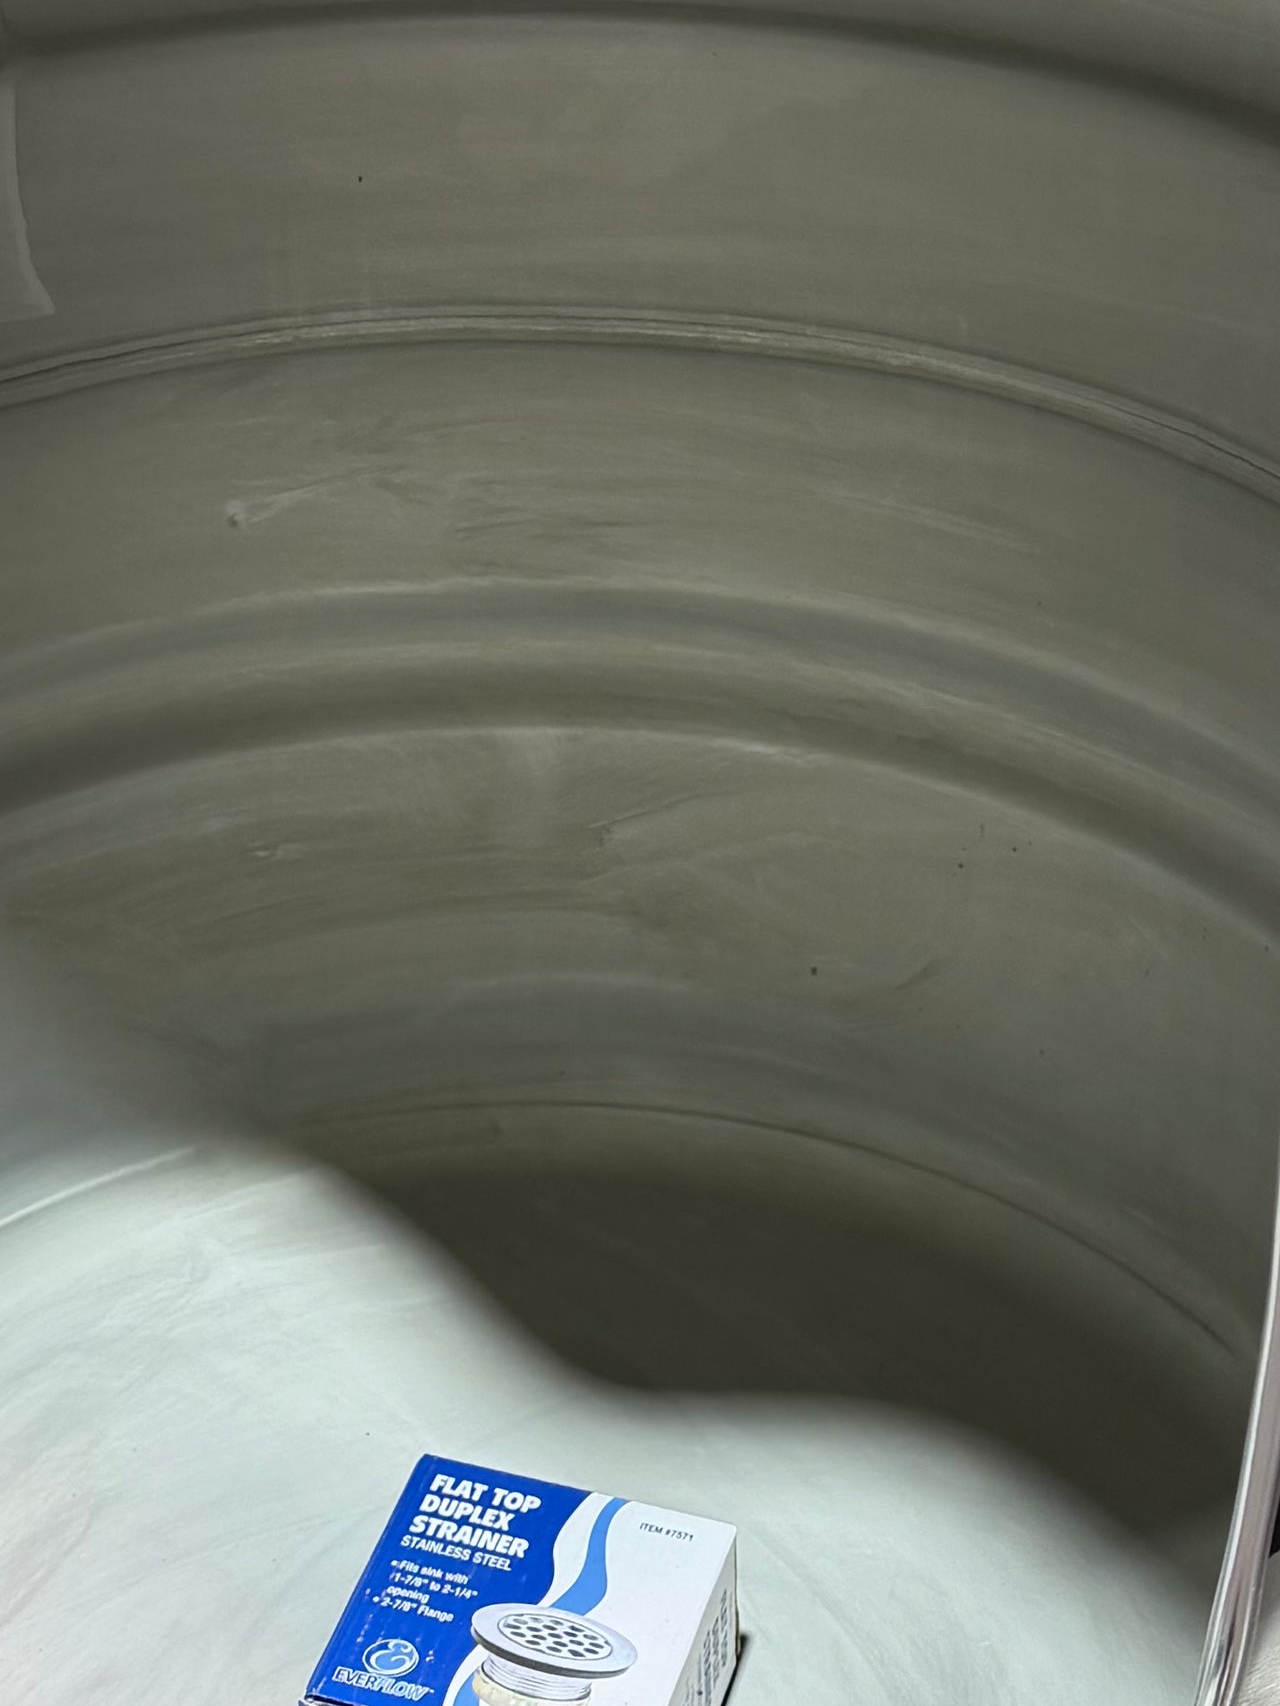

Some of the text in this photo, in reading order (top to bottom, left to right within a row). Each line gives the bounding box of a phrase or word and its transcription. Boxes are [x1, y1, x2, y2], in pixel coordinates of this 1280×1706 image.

[429, 1473, 542, 1514] FLAT TOP
[419, 1494, 515, 1532] DUPLEX
[639, 1522, 663, 1535] ITEM
[400, 1535, 512, 1571] STAINLESS STEEL
[409, 1514, 530, 1558] STRAINER
[386, 1585, 430, 1604] opening
[429, 1580, 441, 1592] to
[445, 1571, 469, 1585] with
[332, 1666, 429, 1702] EVERFLOW
